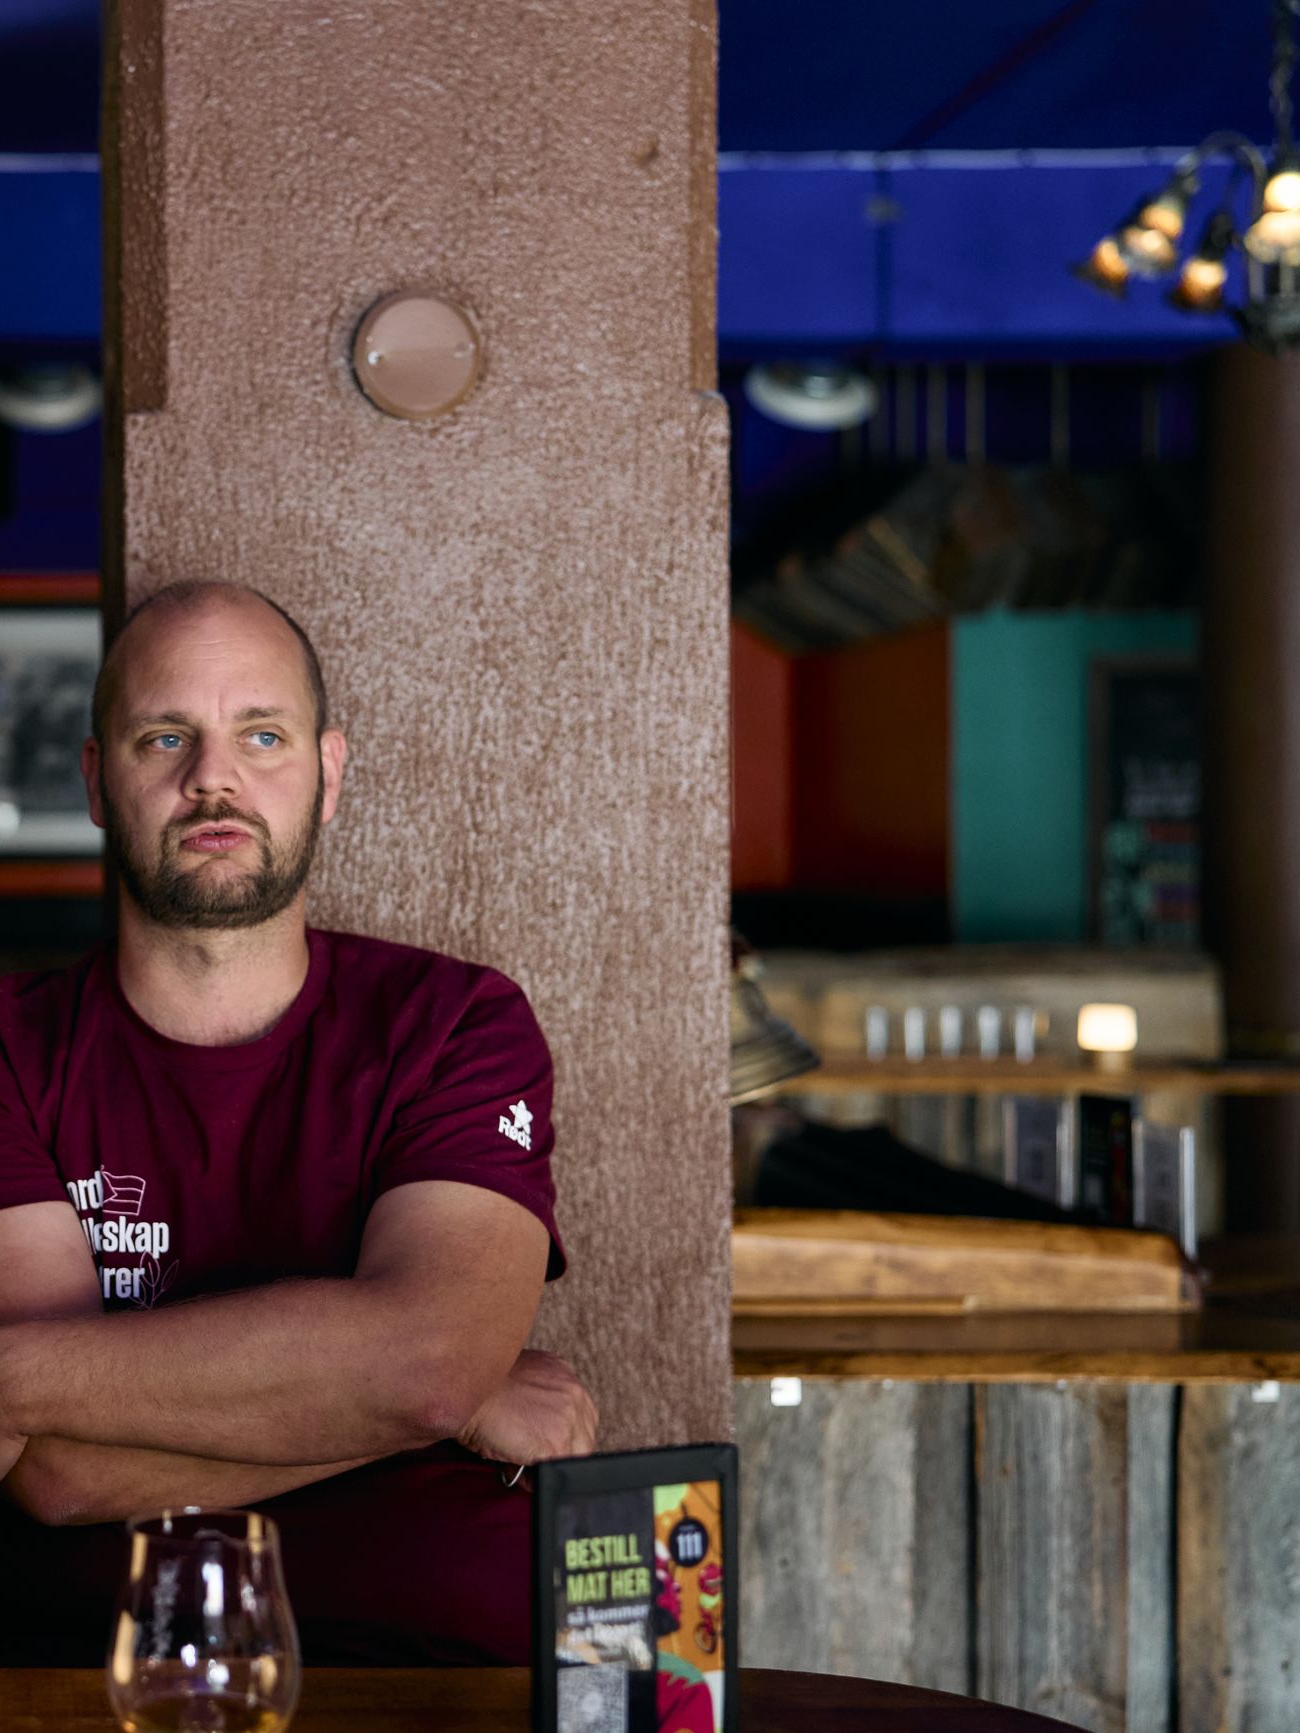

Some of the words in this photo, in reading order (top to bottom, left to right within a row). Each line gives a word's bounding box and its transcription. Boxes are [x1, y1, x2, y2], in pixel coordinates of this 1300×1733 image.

[564, 1533, 642, 1570] BESTILL
[566, 1572, 608, 1604] MAT
[610, 1566, 651, 1600] HER
